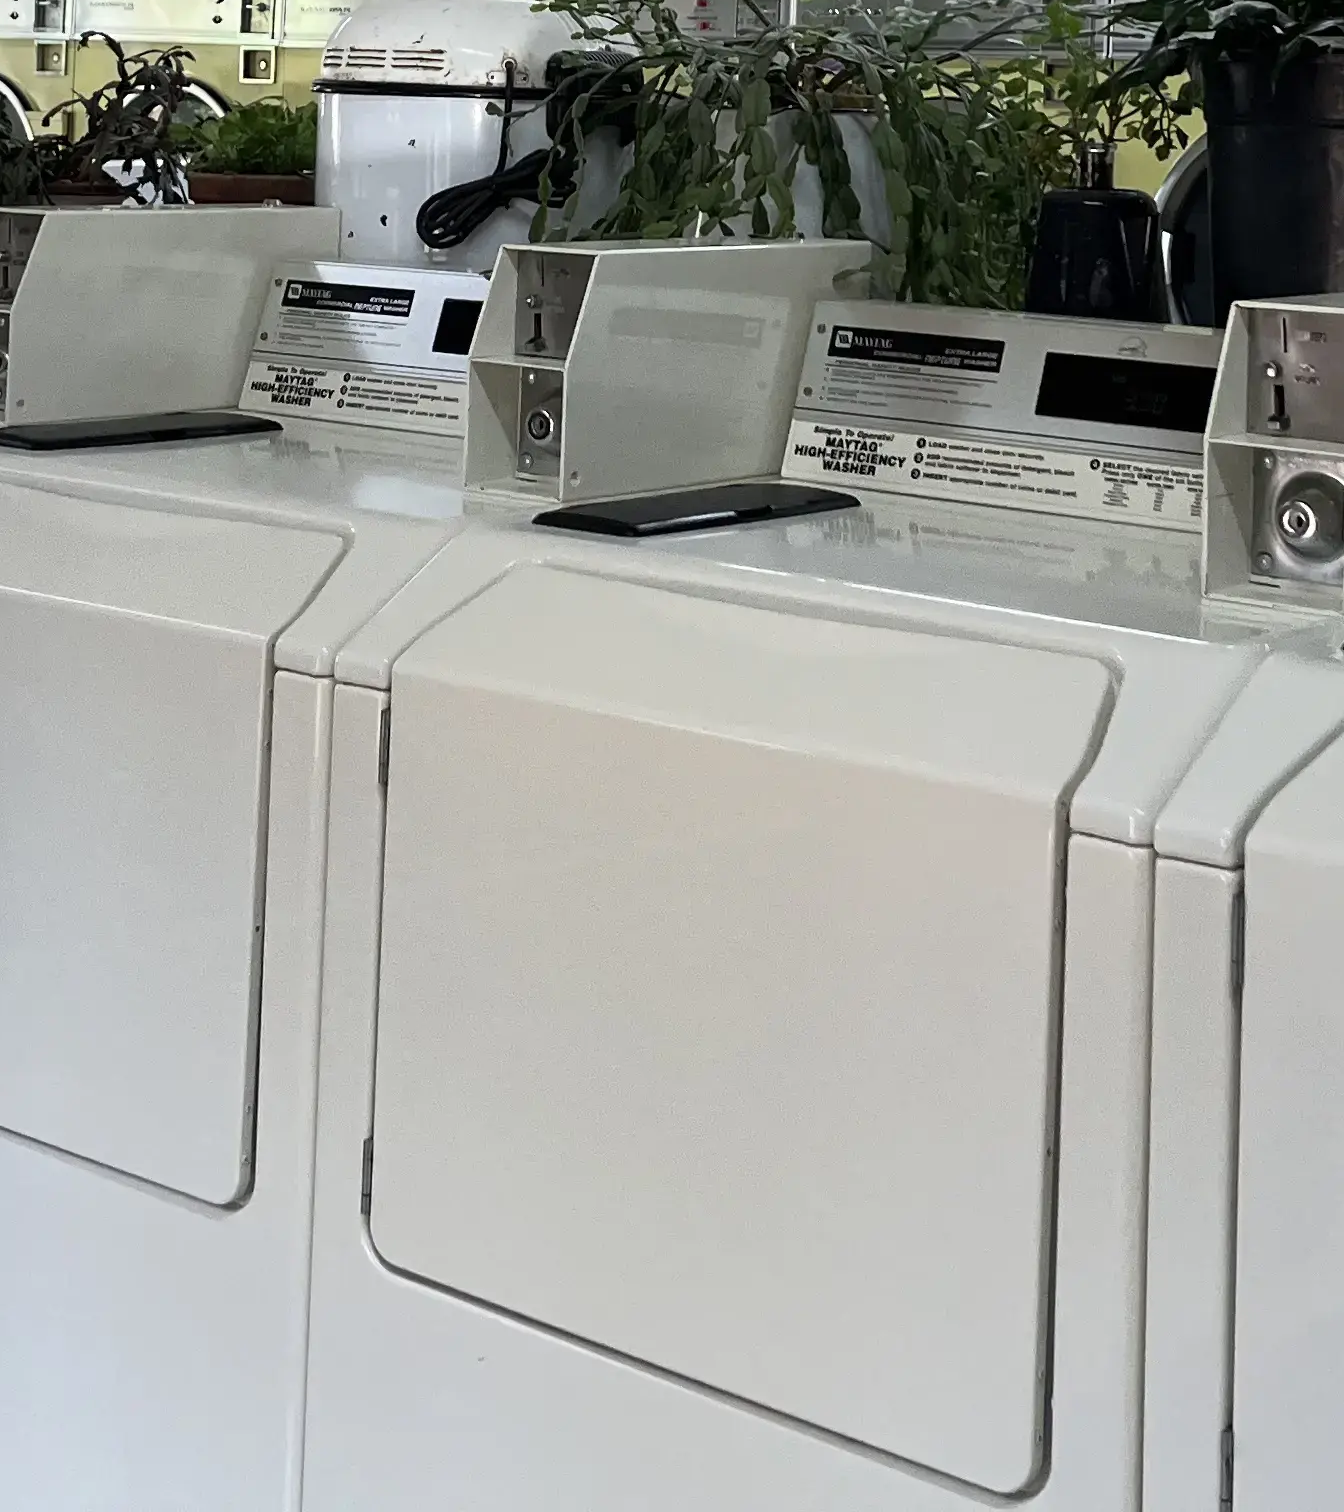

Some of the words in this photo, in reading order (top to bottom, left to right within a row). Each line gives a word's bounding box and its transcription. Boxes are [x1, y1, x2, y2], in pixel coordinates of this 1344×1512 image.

[274, 374, 315, 387] MAYTAG
[250, 381, 335, 399] HIGH-EFFICIENCY
[270, 393, 312, 407] WASHER
[825, 436, 878, 452] MAYTAG
[794, 444, 907, 468] HIGH-EFFICIENCY
[822, 459, 877, 476] WASHER
